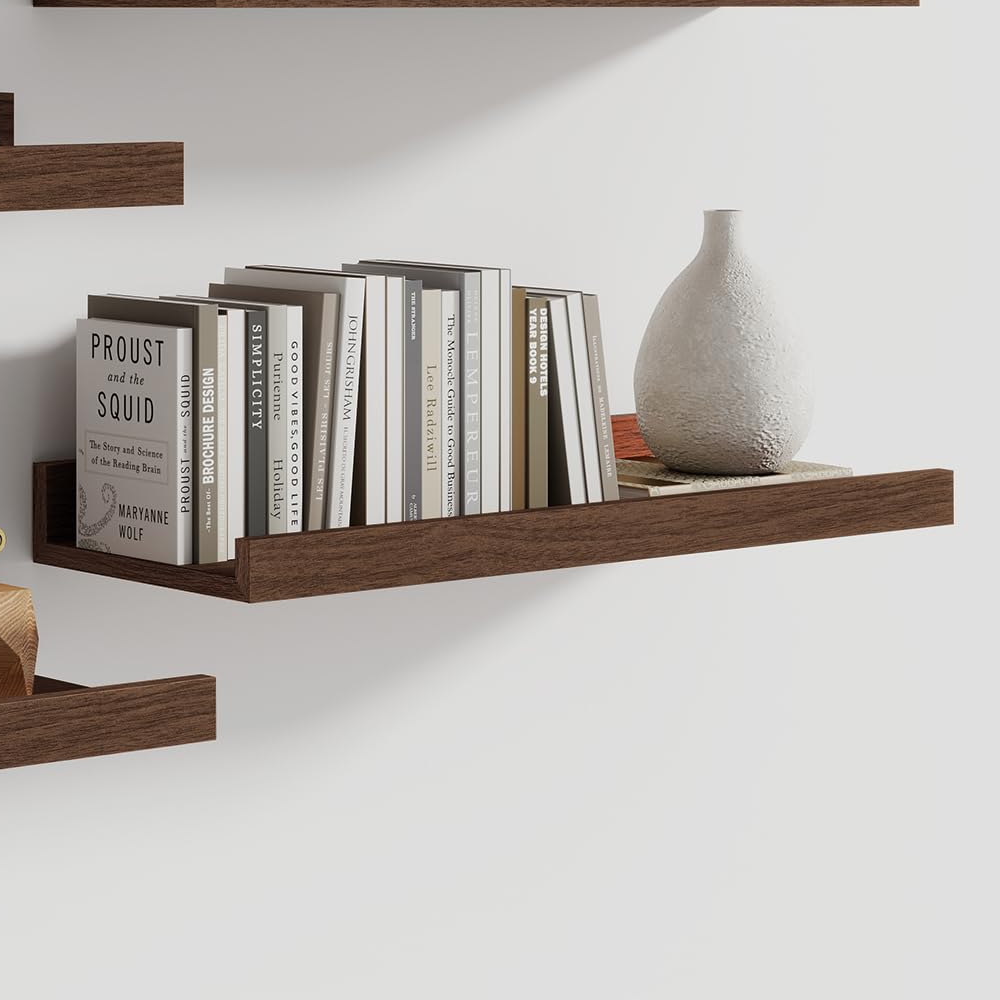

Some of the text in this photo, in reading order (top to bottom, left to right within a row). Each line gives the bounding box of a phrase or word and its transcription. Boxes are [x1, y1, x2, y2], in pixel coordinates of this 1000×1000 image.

[91, 333, 165, 367] PROUST
[291, 341, 299, 385] GOOD
[324, 342, 333, 375] JOURS
[529, 308, 538, 384] YEAR BOOK 9
[540, 308, 548, 397] DESIGN HOTELS
[107, 372, 145, 386] and the
[180, 374, 191, 418] SQUID
[252, 324, 262, 430] SIMPLICITY
[322, 379, 331, 398] LES
[97, 391, 154, 424] SQUID
[202, 367, 215, 485] BROCHURE DESIGN
[427, 365, 437, 472] Lee Radziwill
[447, 314, 455, 517] The Monocle Guide to Good Business
[89, 439, 164, 460] The Story and Science
[270, 352, 284, 520] Purienne Holiday
[317, 412, 329, 473] PLAISIRS
[599, 397, 609, 441] MADELEINE
[604, 444, 612, 478] LEMAIRE
[91, 456, 161, 475] of the Reading Brain
[180, 458, 190, 513] PROUST
[291, 442, 299, 487] GOOD
[291, 493, 299, 526] LIFE
[315, 477, 324, 502] LES
[119, 503, 169, 525] MARYANNE
[119, 524, 144, 542] WOLF
